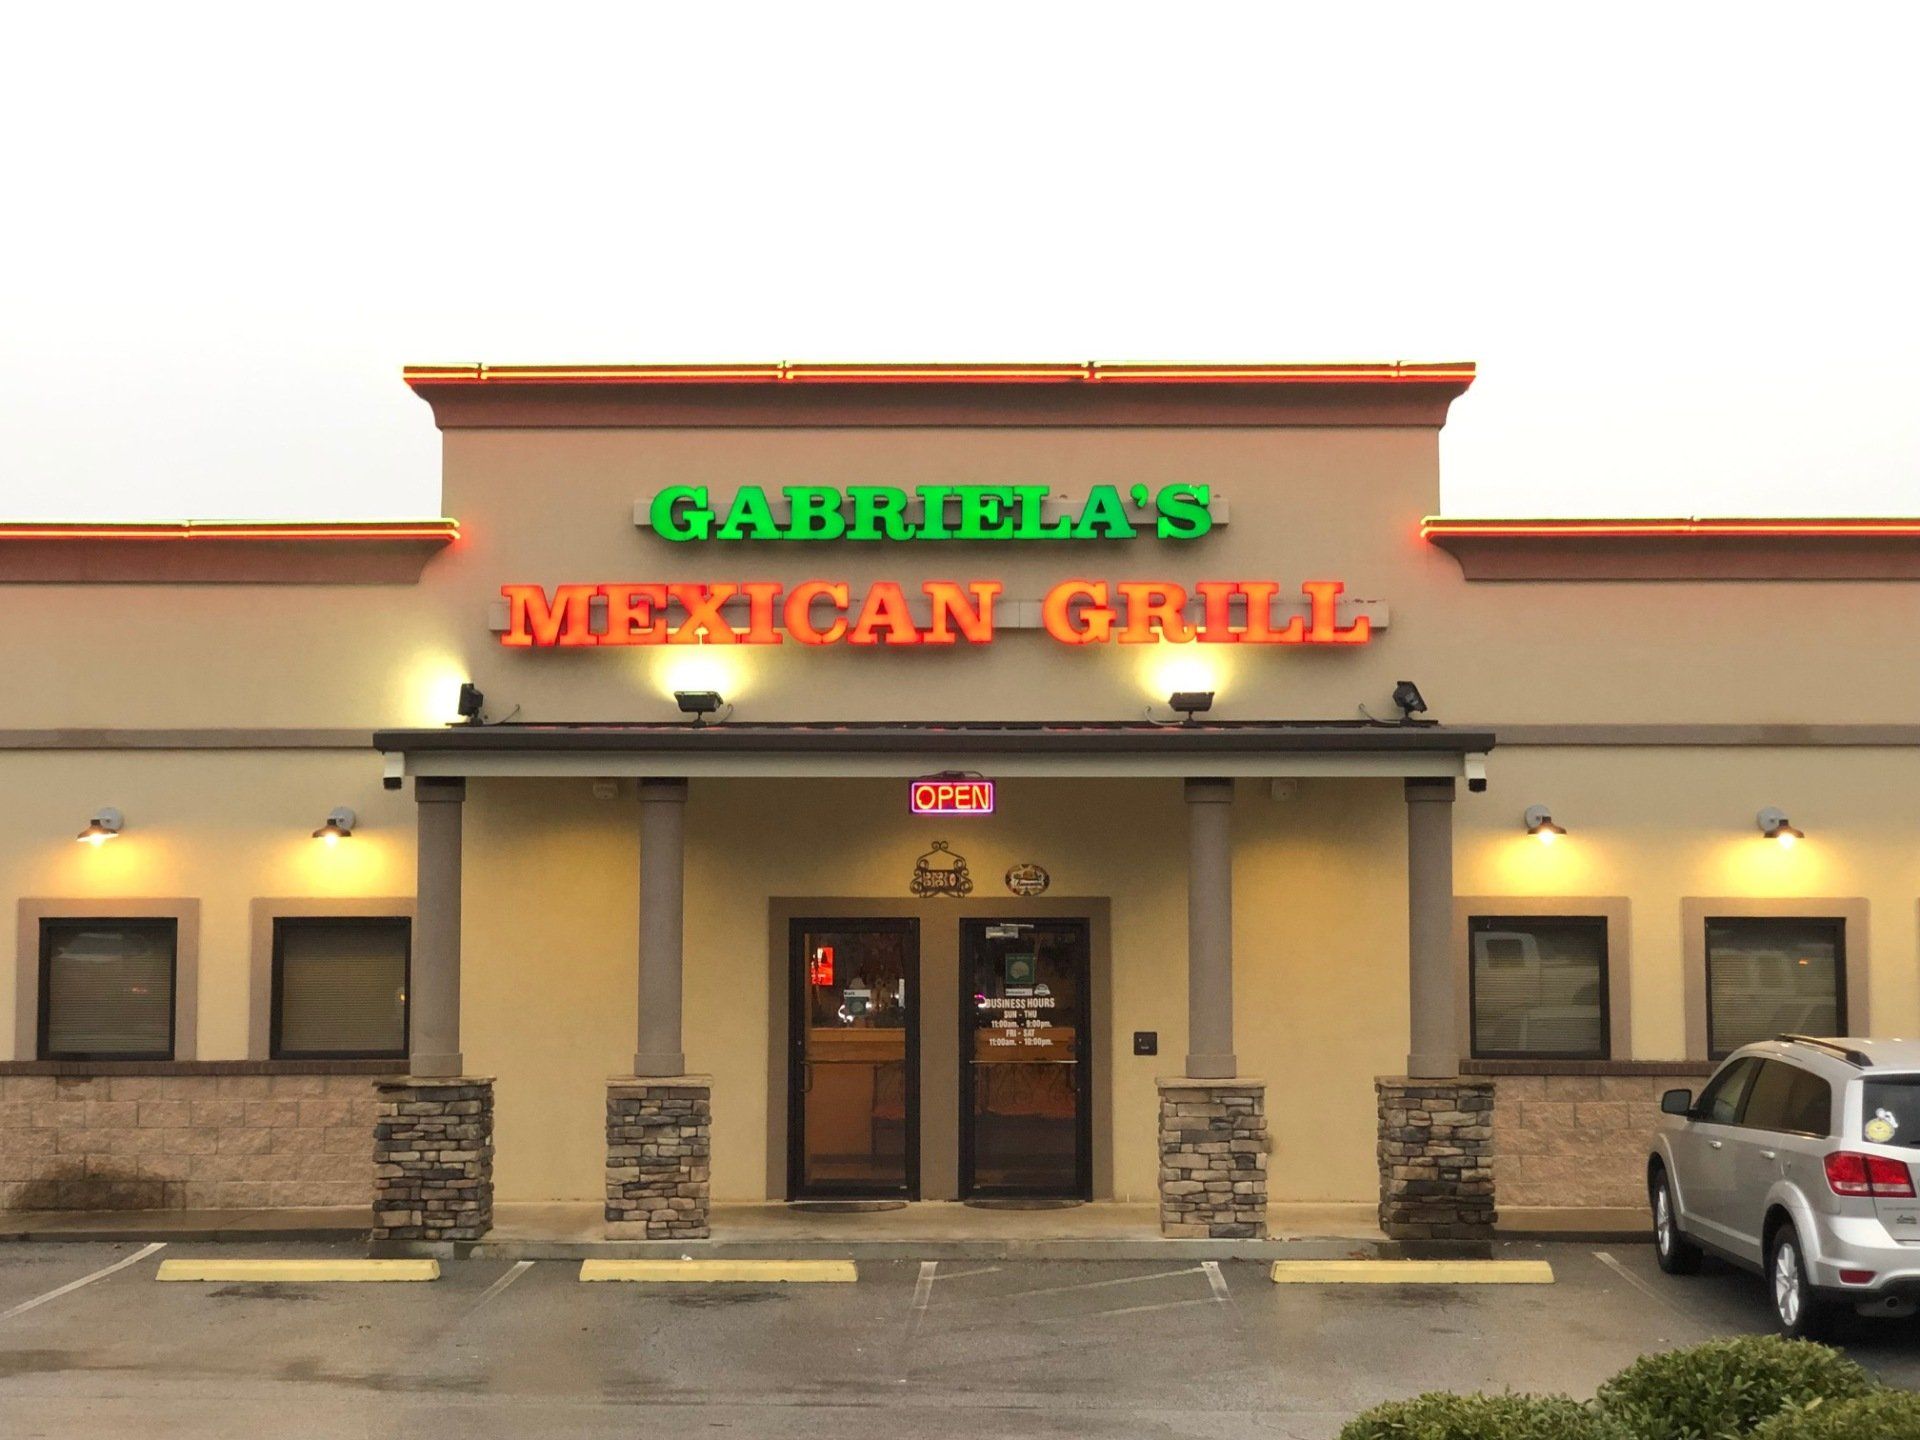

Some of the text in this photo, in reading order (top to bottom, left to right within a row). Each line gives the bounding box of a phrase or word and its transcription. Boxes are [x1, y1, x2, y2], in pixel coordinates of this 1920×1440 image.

[650, 484, 1213, 541] GABRIELA'S
[500, 580, 1370, 646] MEXICAN GRILL
[915, 785, 989, 810] OPEN
[986, 998, 1055, 1009] BUSINESS HOURS
[1004, 1010, 1018, 1019] SUN
[1024, 1010, 1038, 1019] THU
[1006, 1029, 1017, 1037] FRI
[1023, 1029, 1035, 1037] SAT
